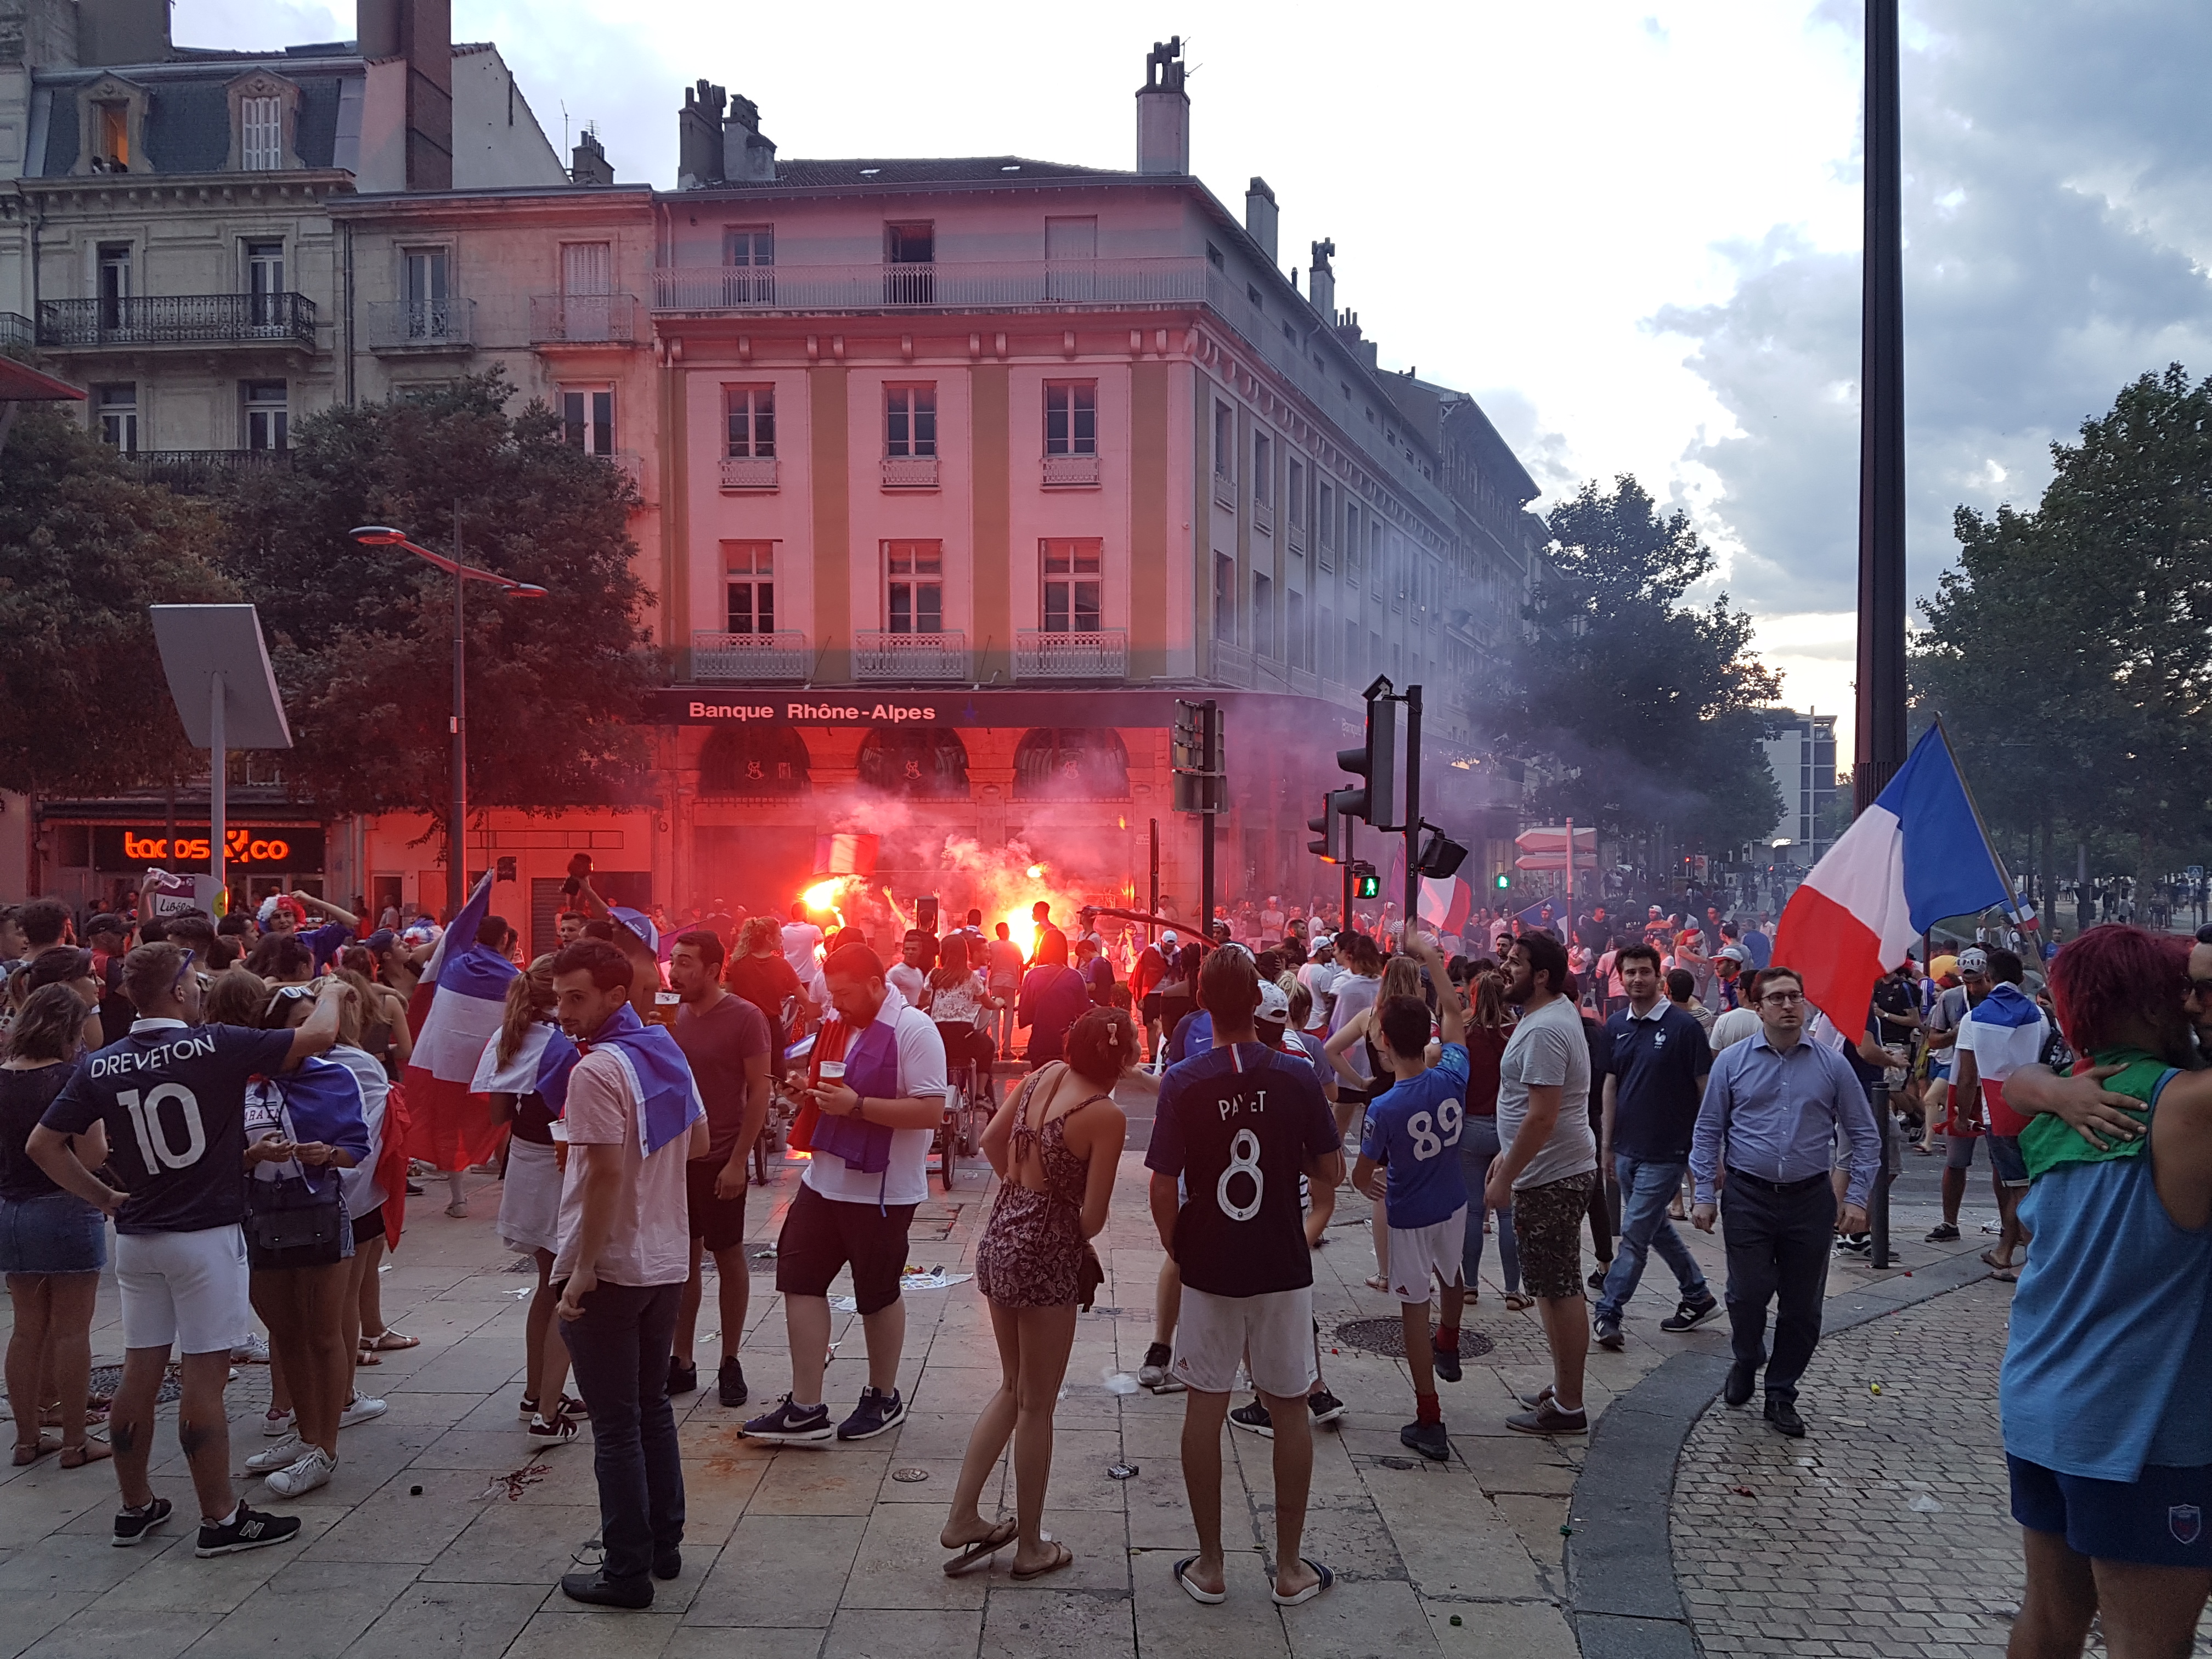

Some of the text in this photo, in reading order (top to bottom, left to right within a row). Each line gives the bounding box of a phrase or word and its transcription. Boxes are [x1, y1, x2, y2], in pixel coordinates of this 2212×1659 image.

[689, 702, 936, 724] Banque Rhône-Alpes
[91, 1034, 216, 1079] DREVETON
[116, 1082, 206, 1175] 10
[1407, 1098, 1463, 1161] 89
[1217, 1128, 1264, 1221] 8
[239, 1520, 265, 1538] N
